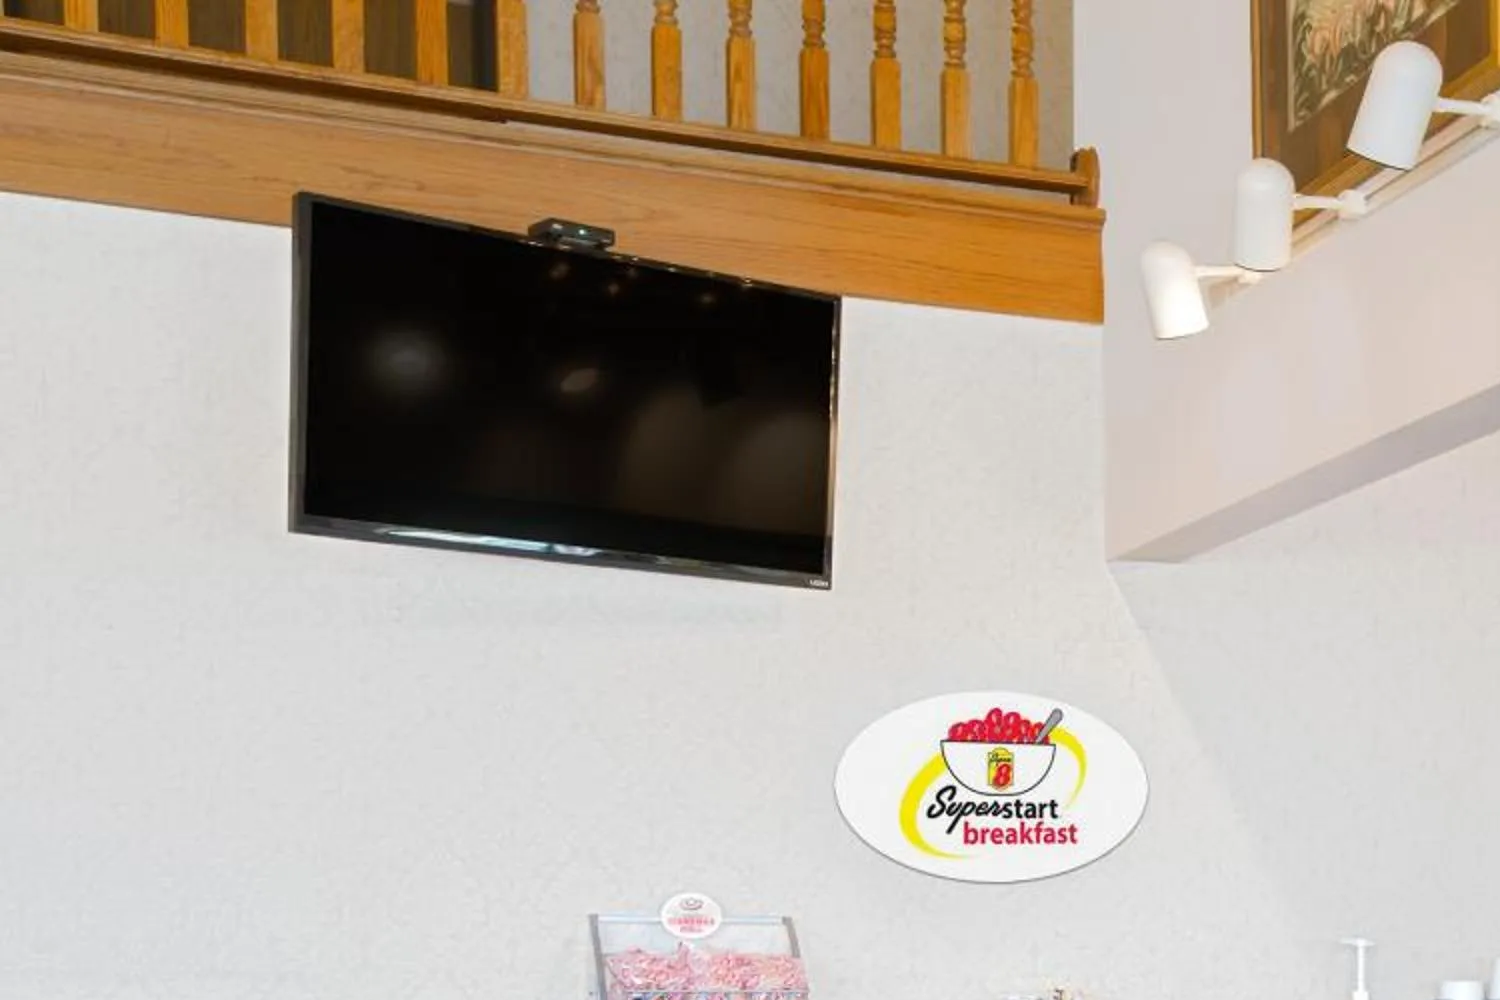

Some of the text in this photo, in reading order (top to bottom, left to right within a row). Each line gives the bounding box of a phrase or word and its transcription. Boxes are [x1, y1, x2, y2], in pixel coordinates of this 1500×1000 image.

[992, 763, 1011, 788] 8
[926, 785, 1059, 834] Superstart
[963, 821, 1079, 845] breakfast
